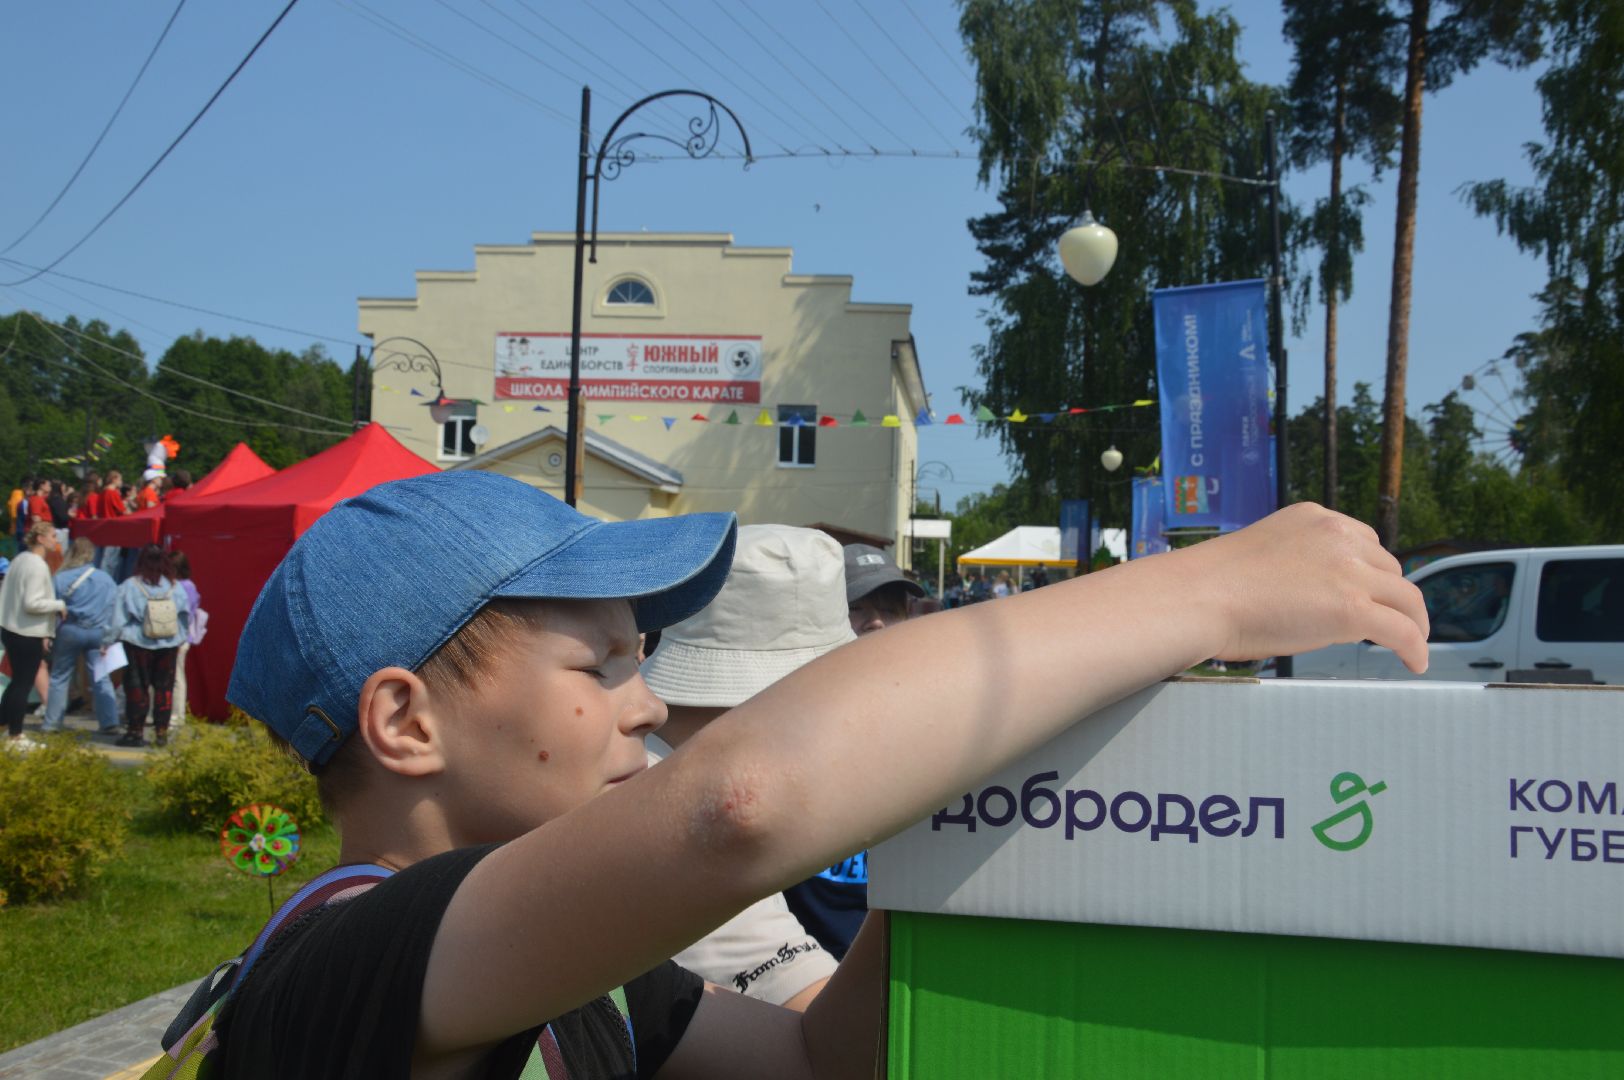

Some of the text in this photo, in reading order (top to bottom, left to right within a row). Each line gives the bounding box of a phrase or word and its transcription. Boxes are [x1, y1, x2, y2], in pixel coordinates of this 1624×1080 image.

[565, 346, 599, 356] ЦНТР
[643, 342, 719, 363] ЮЖНЫЙ
[540, 359, 623, 371] ЕДИНБОРСТВ
[643, 365, 719, 375] СПОРТИВНЫЙ КЛУБ
[511, 383, 744, 400] ШКОЛА ЛИМПИЙСКОГО КАРАТЕ
[1184, 314, 1204, 467] С ПРАЗДНИКОМ!
[1510, 778, 1624, 815] КОМ
[932, 770, 1285, 844] добродел
